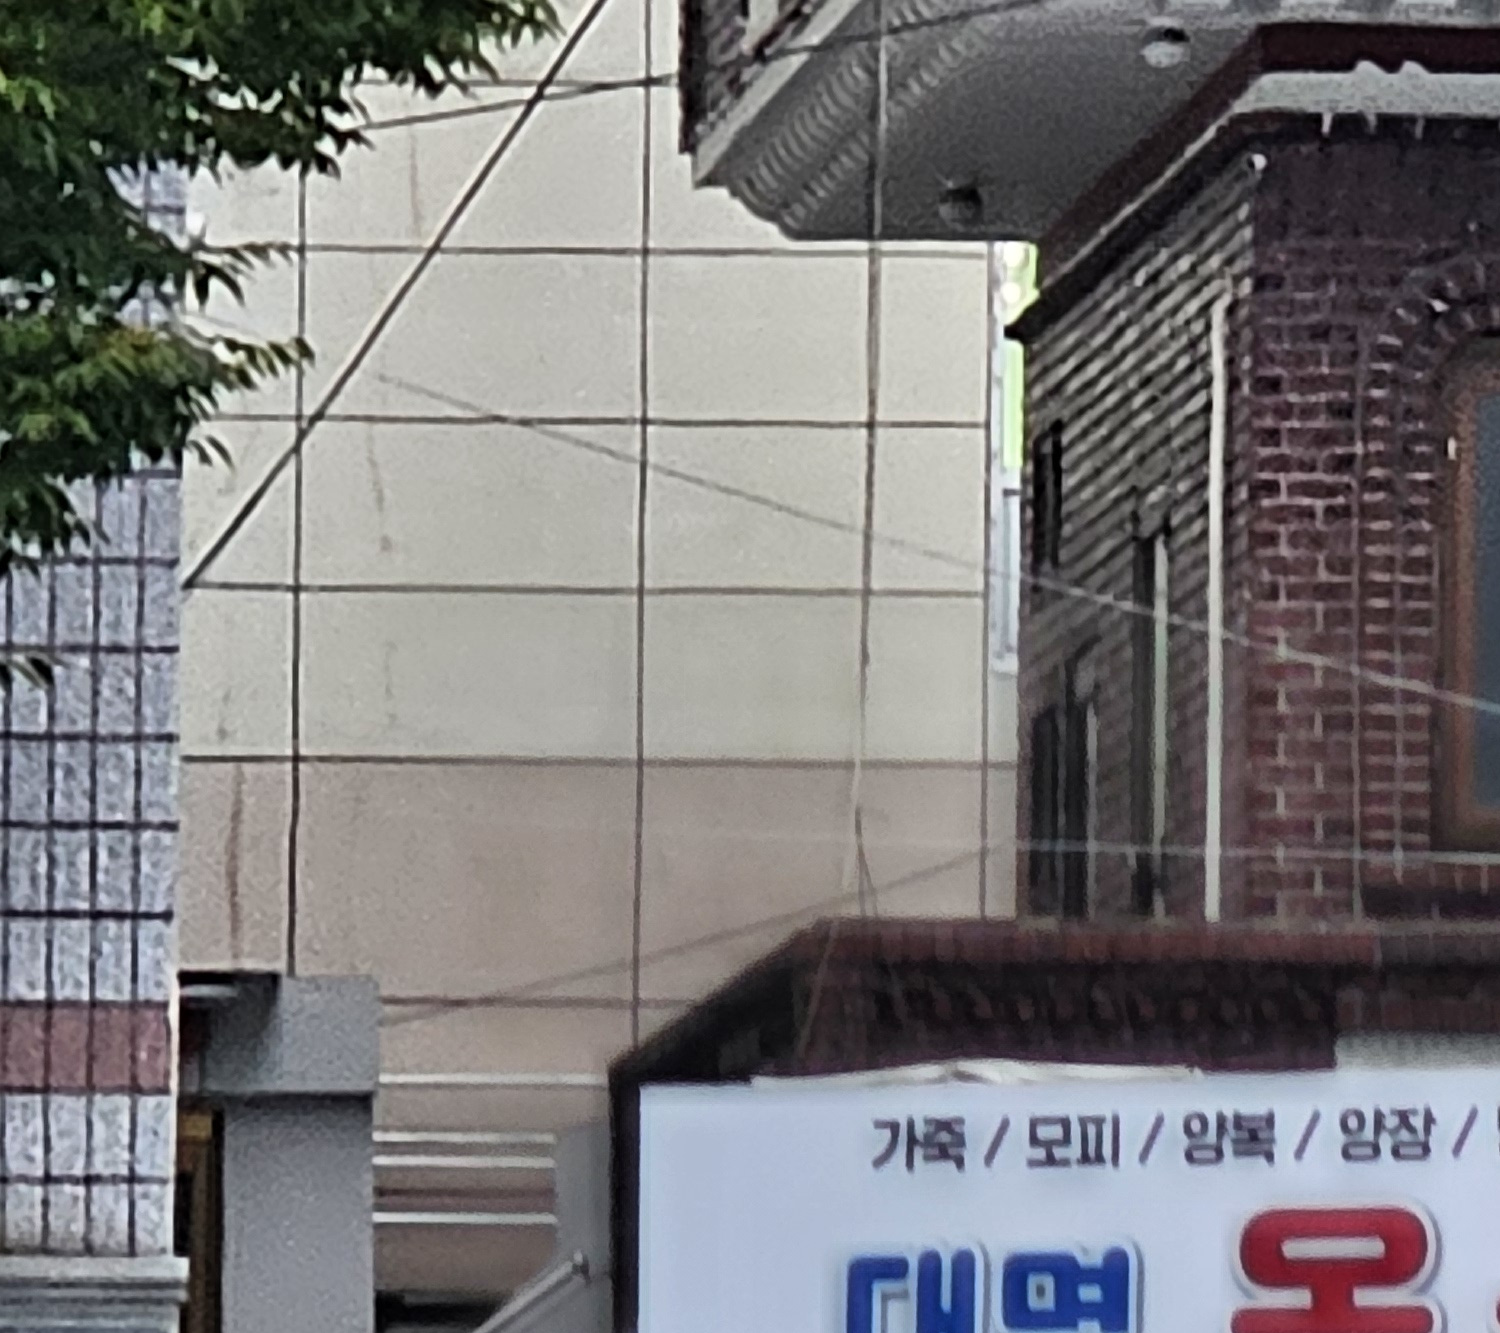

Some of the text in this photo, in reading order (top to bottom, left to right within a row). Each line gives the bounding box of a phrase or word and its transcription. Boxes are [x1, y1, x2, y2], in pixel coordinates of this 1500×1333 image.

[872, 1116, 967, 1173] 가죽
[1026, 1112, 1121, 1171] 모피
[1182, 1107, 1277, 1168] 양복
